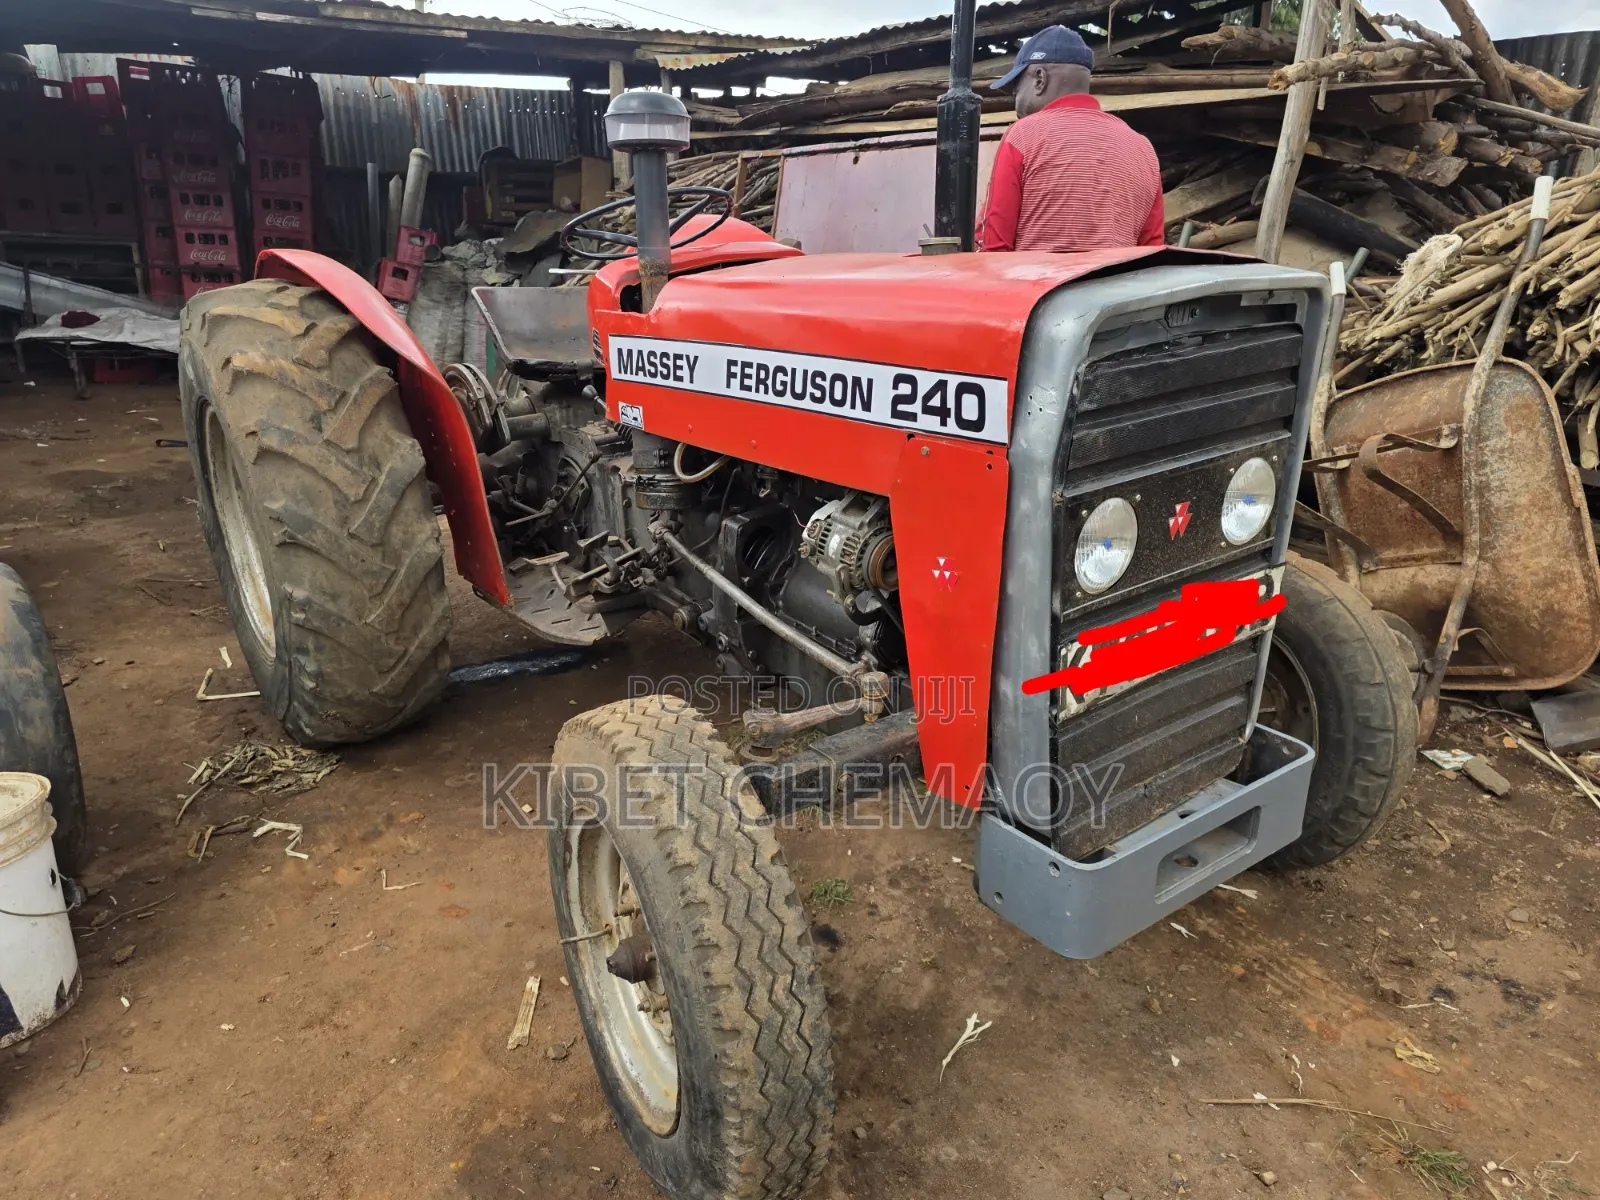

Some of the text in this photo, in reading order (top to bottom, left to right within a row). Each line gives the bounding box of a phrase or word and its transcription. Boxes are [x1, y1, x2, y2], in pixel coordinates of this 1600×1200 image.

[617, 347, 986, 433] MASSEY FERGUSON 240
